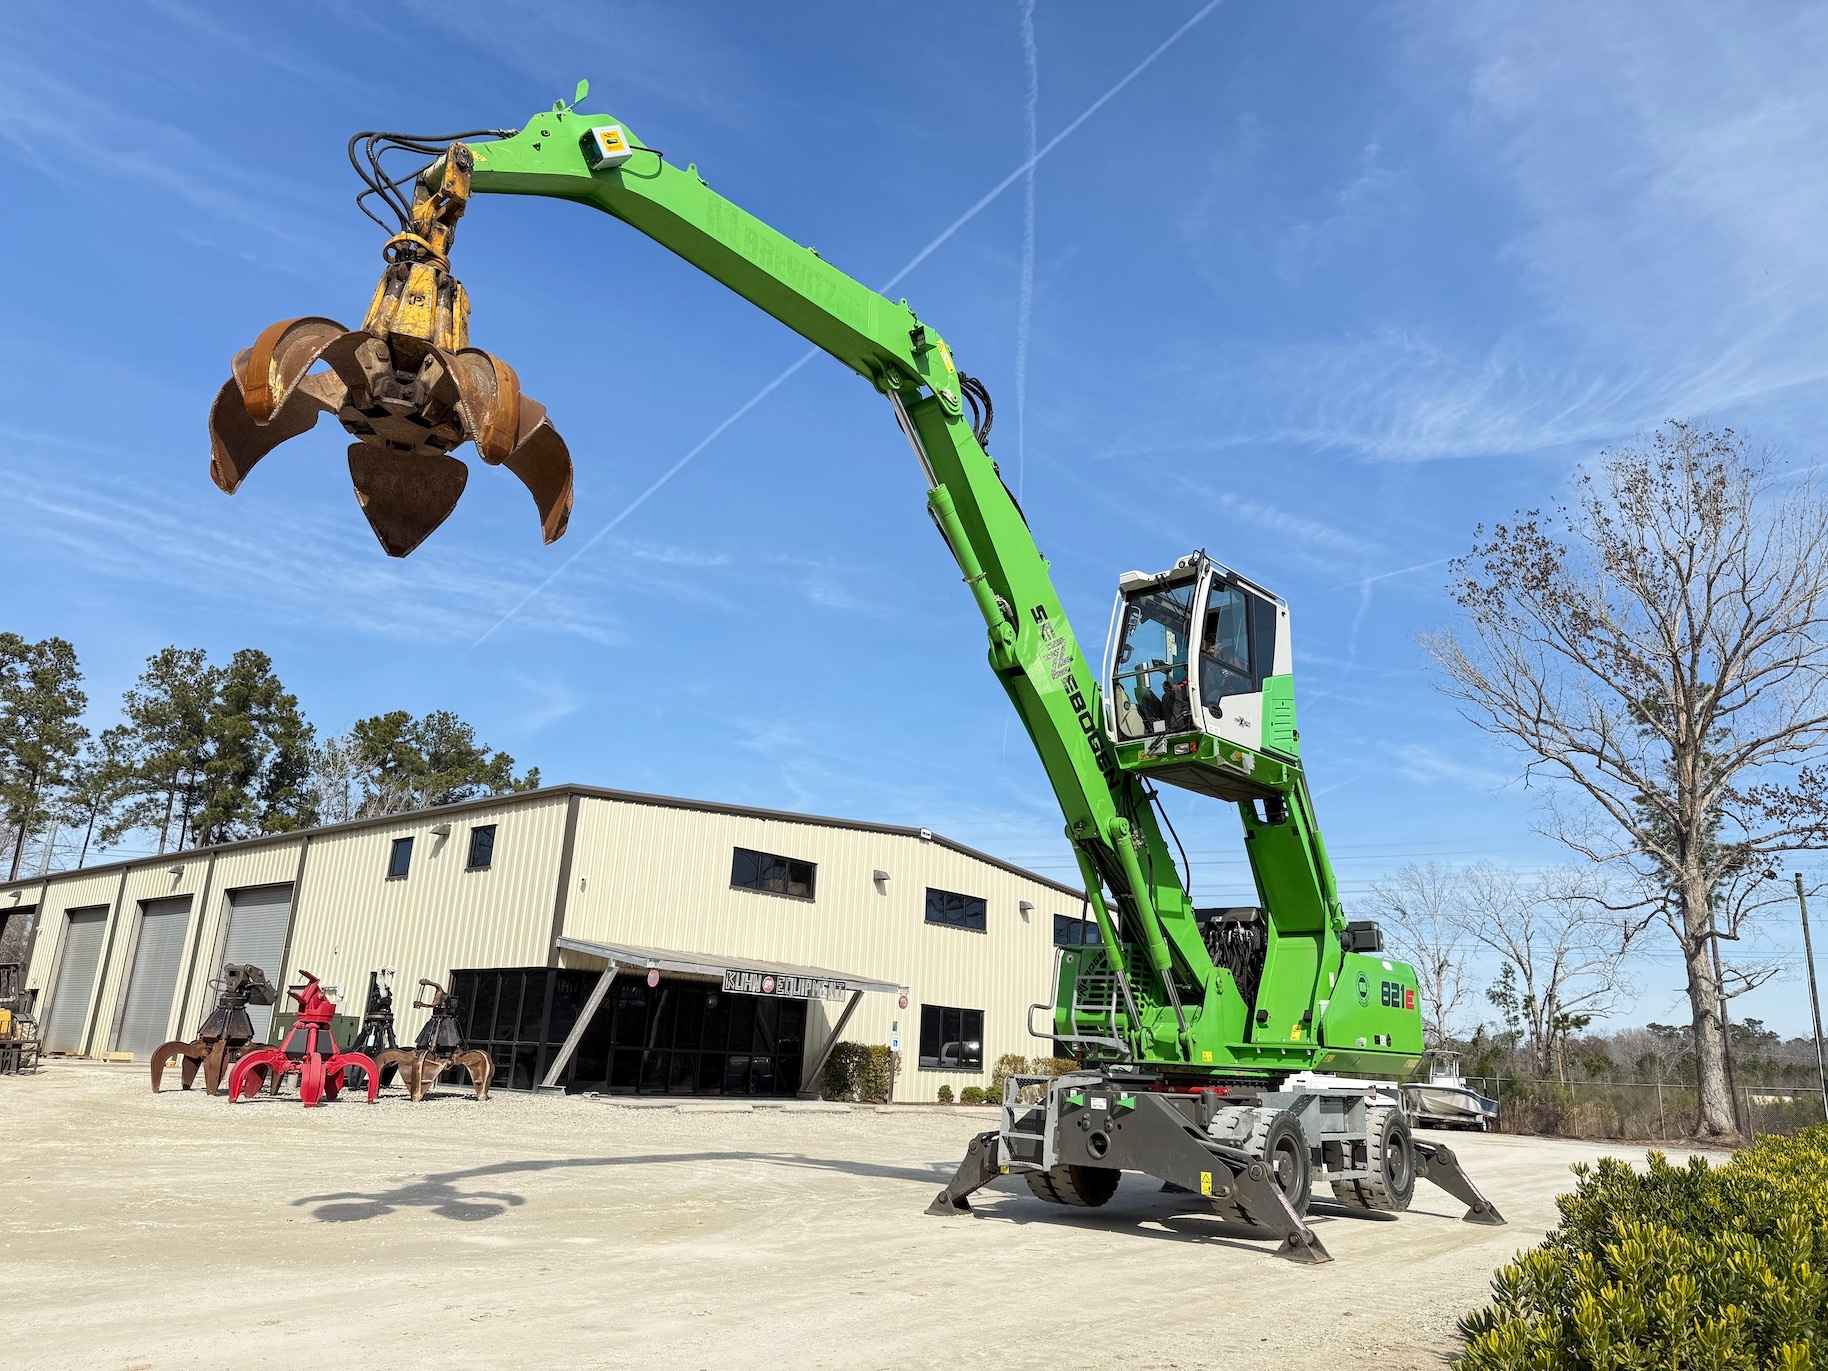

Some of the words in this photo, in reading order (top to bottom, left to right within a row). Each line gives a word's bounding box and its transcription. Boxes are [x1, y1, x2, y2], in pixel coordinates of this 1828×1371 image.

[1030, 604, 1121, 792] SENNEBOGEN
[725, 971, 762, 992] KUHN
[776, 976, 845, 1001] EQUIPMENT
